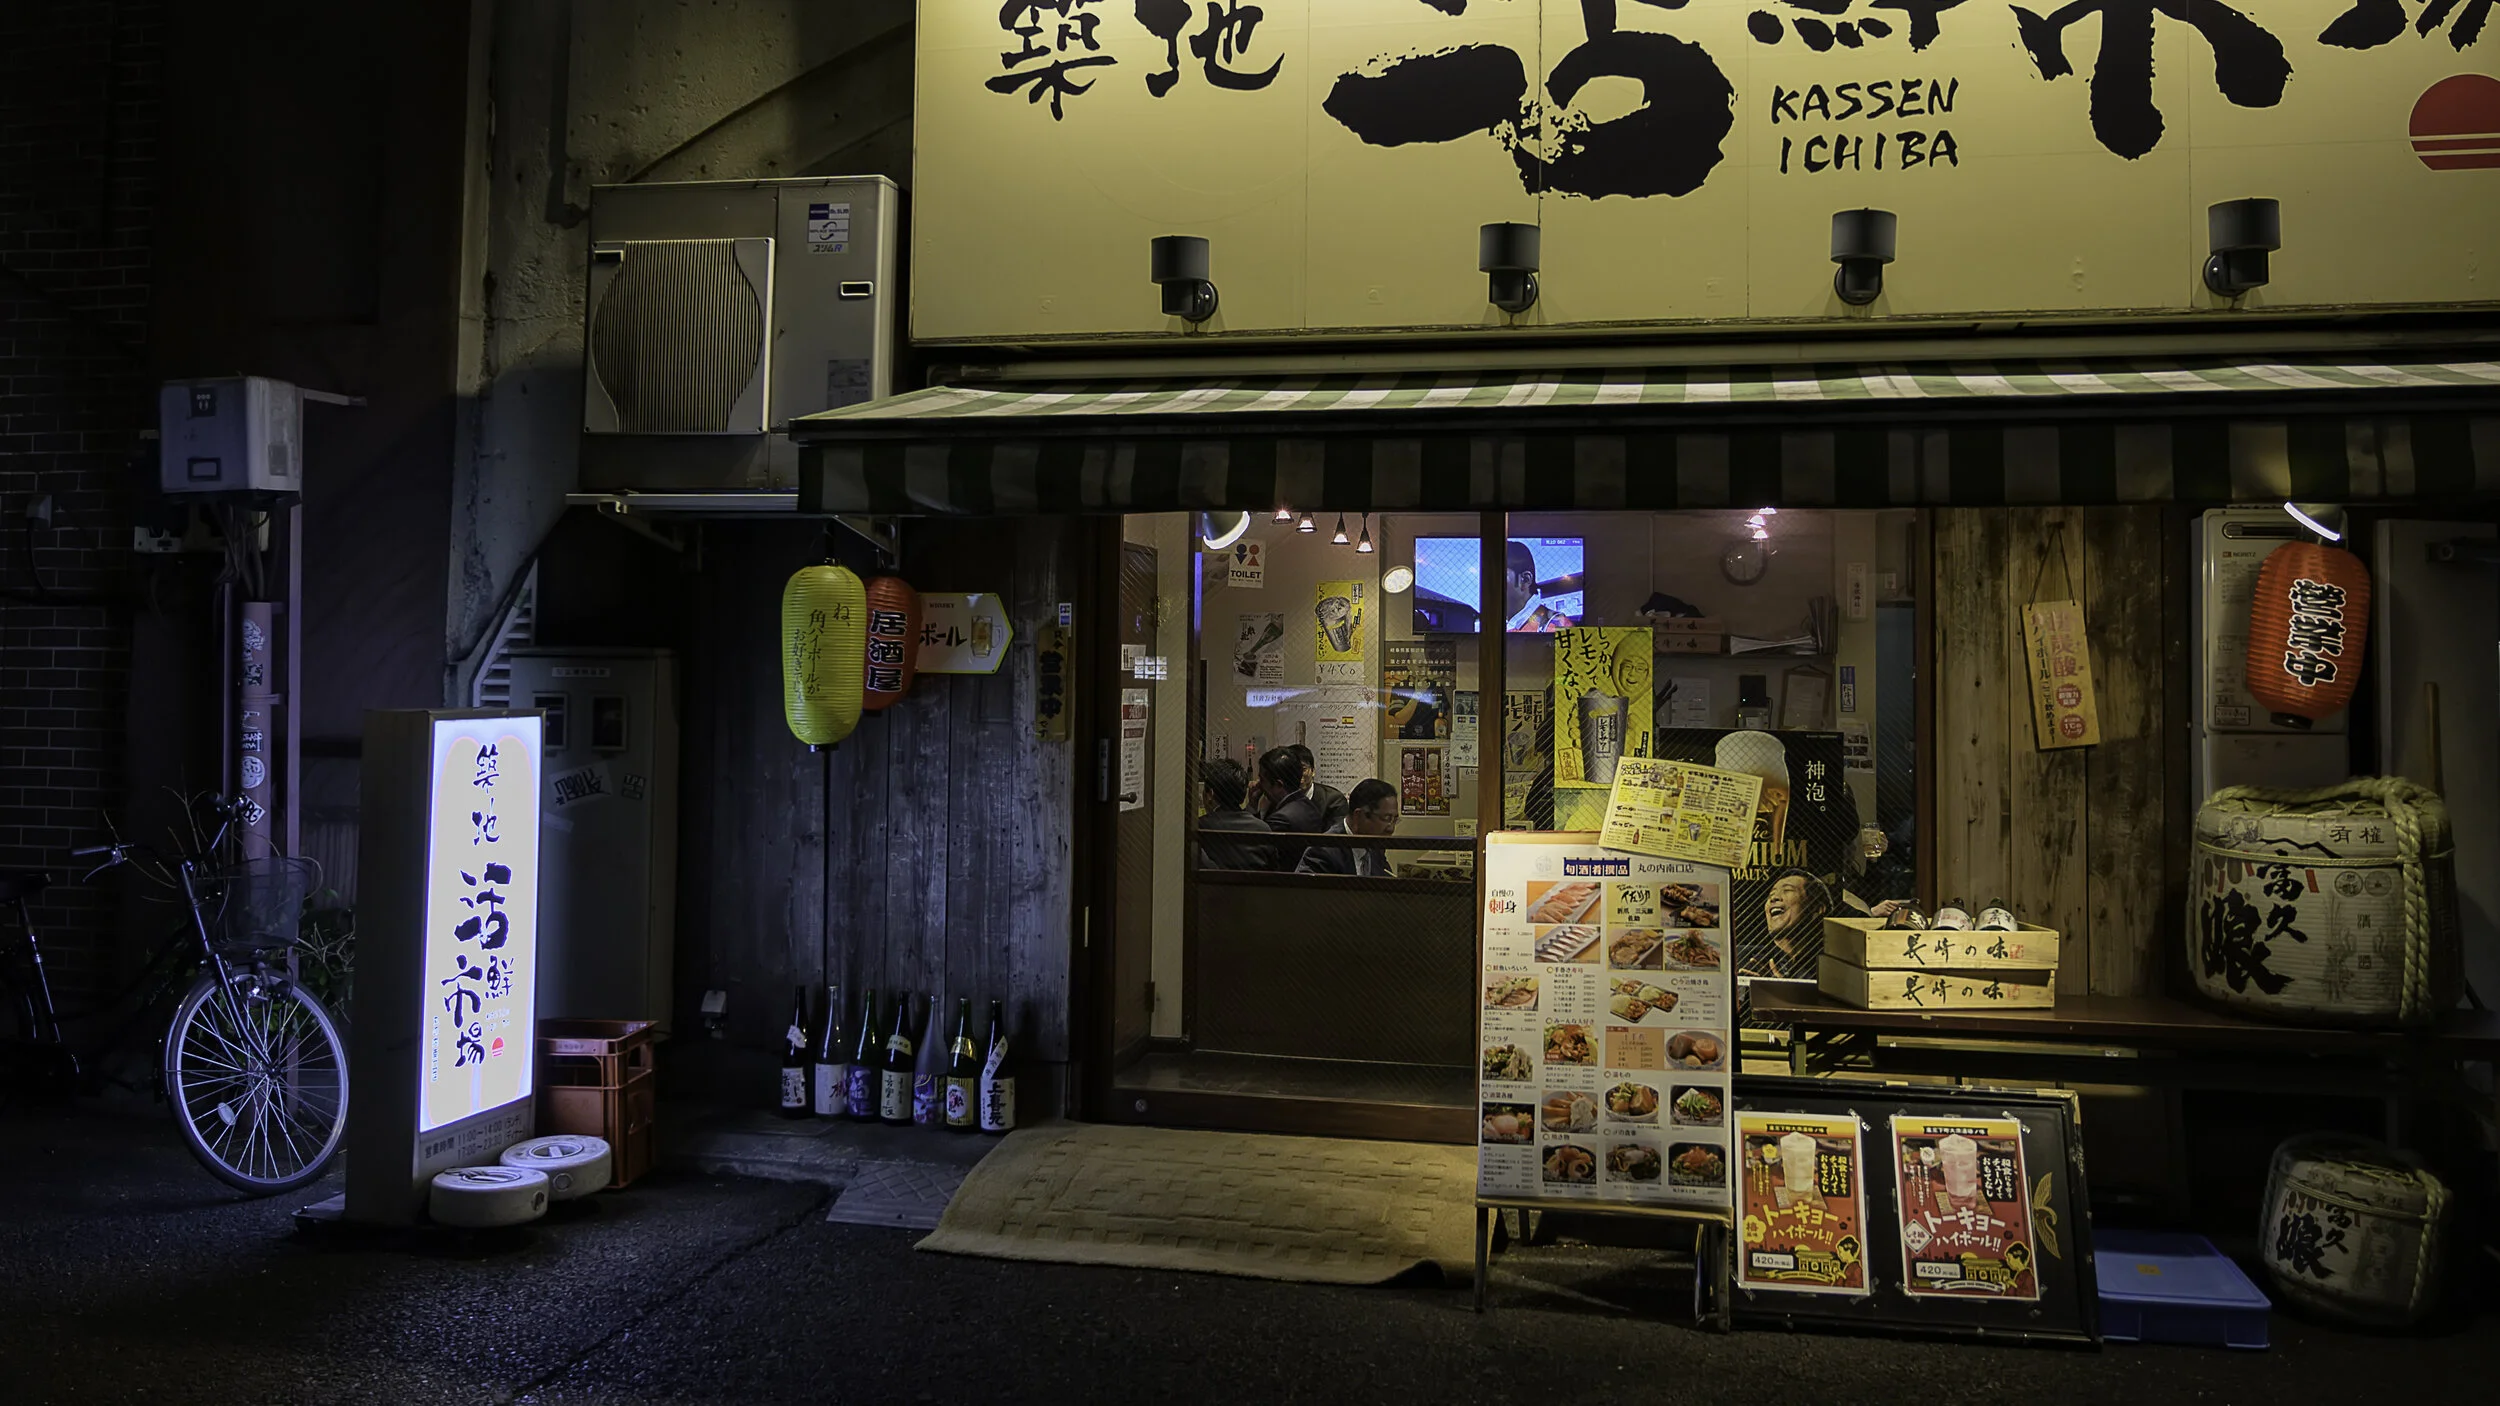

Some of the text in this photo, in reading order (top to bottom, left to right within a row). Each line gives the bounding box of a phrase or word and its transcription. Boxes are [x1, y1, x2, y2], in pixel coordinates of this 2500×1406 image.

[1771, 78, 1959, 124] KASSEN
[1779, 129, 1959, 174] ICHIBA
[1231, 570, 1262, 579] TOILET
[807, 608, 827, 696] 角ハイボールが
[867, 610, 907, 693] 居酒屋
[1598, 627, 1612, 678] しっかり
[2283, 578, 2347, 687] 営業中
[1580, 628, 1598, 686] レモンで
[472, 743, 501, 846] 築地
[1805, 759, 1826, 813] 神泡。
[1637, 863, 1694, 874] 丸の内南口店
[1489, 898, 1517, 914] 刺身
[1903, 933, 2009, 966] 長崎の味
[1902, 975, 2003, 1007] 長崎の味
[425, 1137, 455, 1160] 営業時間
[1763, 1200, 1839, 1227] トーキョー
[1923, 1206, 2005, 1234] トーキョー
